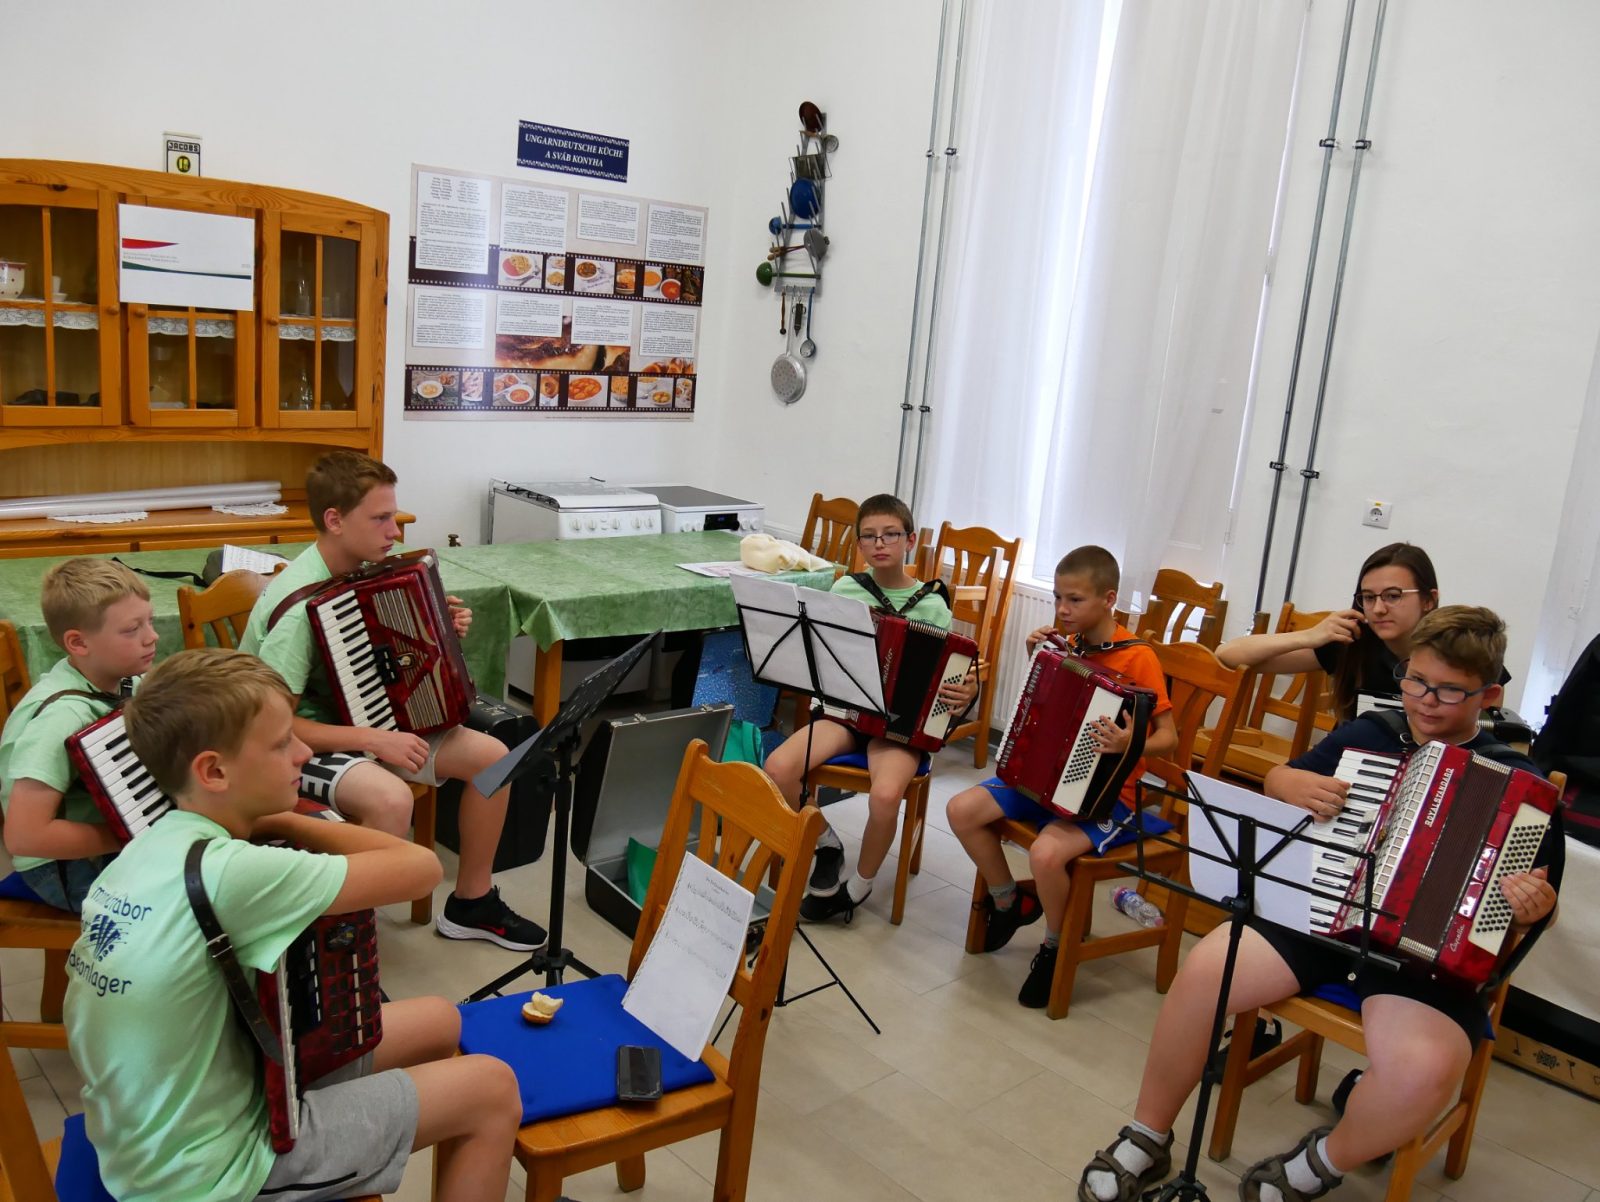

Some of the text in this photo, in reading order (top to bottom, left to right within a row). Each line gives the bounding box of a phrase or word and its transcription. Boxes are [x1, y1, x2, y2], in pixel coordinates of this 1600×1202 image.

[168, 142, 199, 152] JACOBS
[525, 133, 624, 159] UNGARNDEUTSCHE KÜCHE
[544, 151, 604, 167] A SVÁB KONYHA
